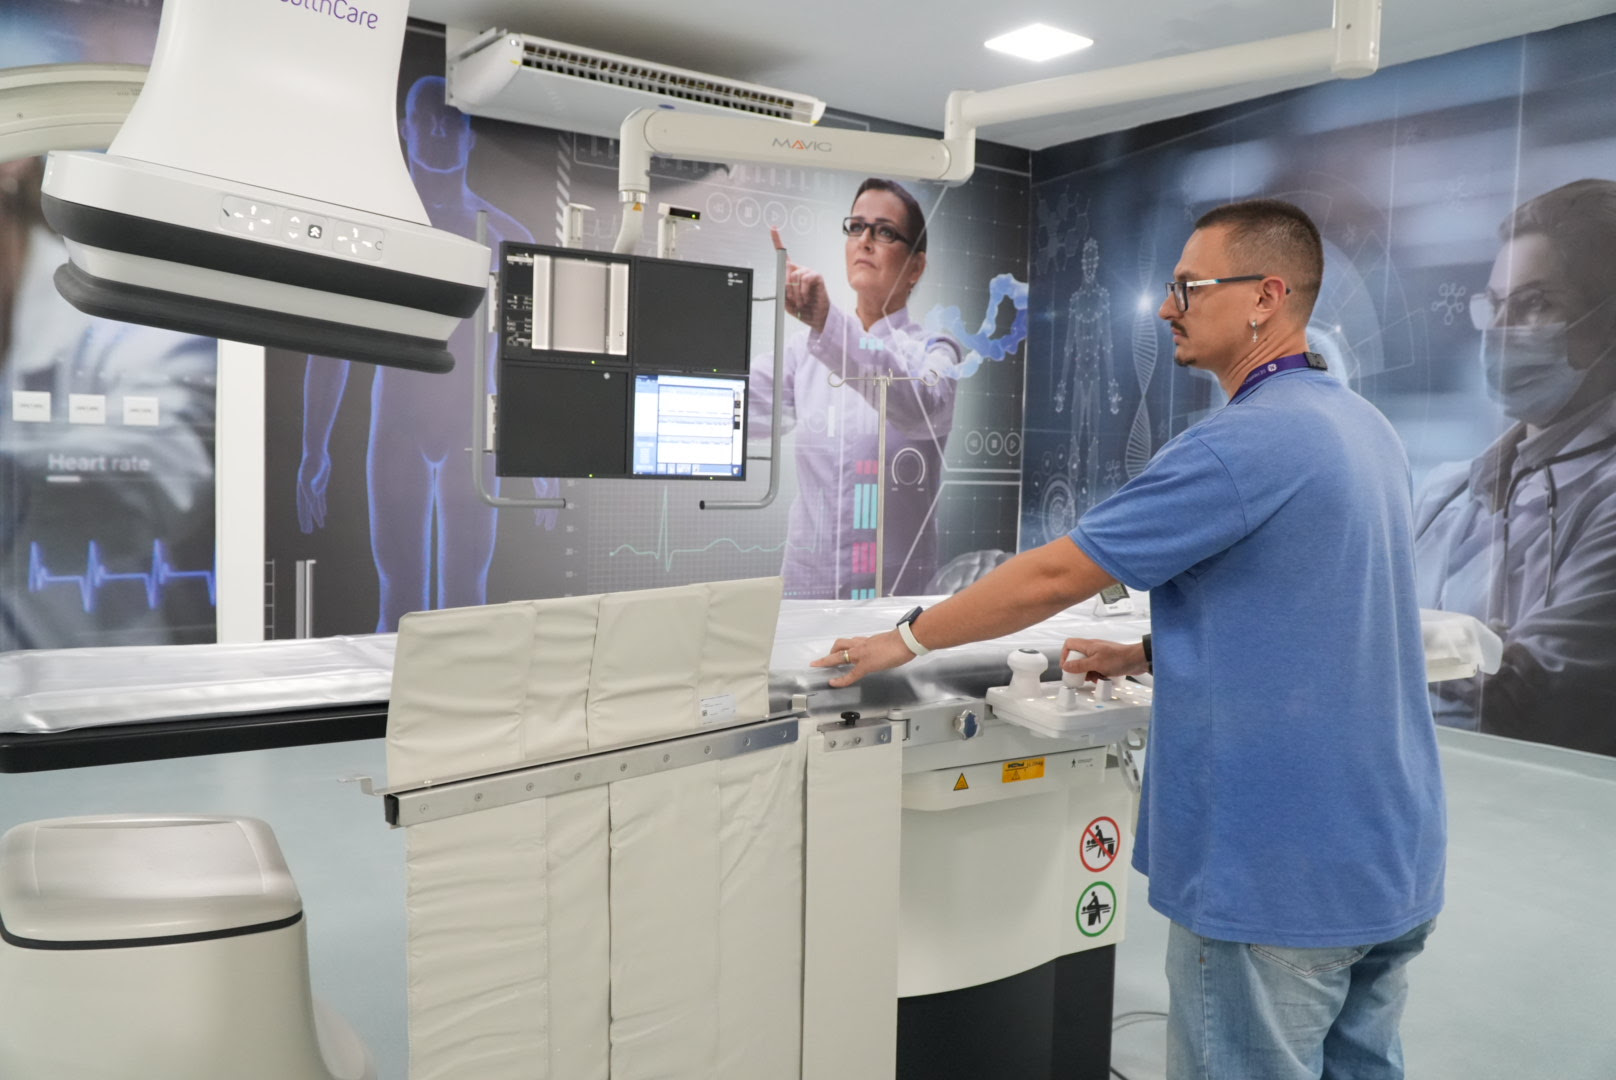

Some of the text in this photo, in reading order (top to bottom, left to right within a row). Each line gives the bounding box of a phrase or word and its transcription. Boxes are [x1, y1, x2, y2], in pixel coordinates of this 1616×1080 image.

[281, 0, 379, 29] thCare
[771, 137, 833, 153] MAVIG
[48, 454, 152, 472] Heart rate
